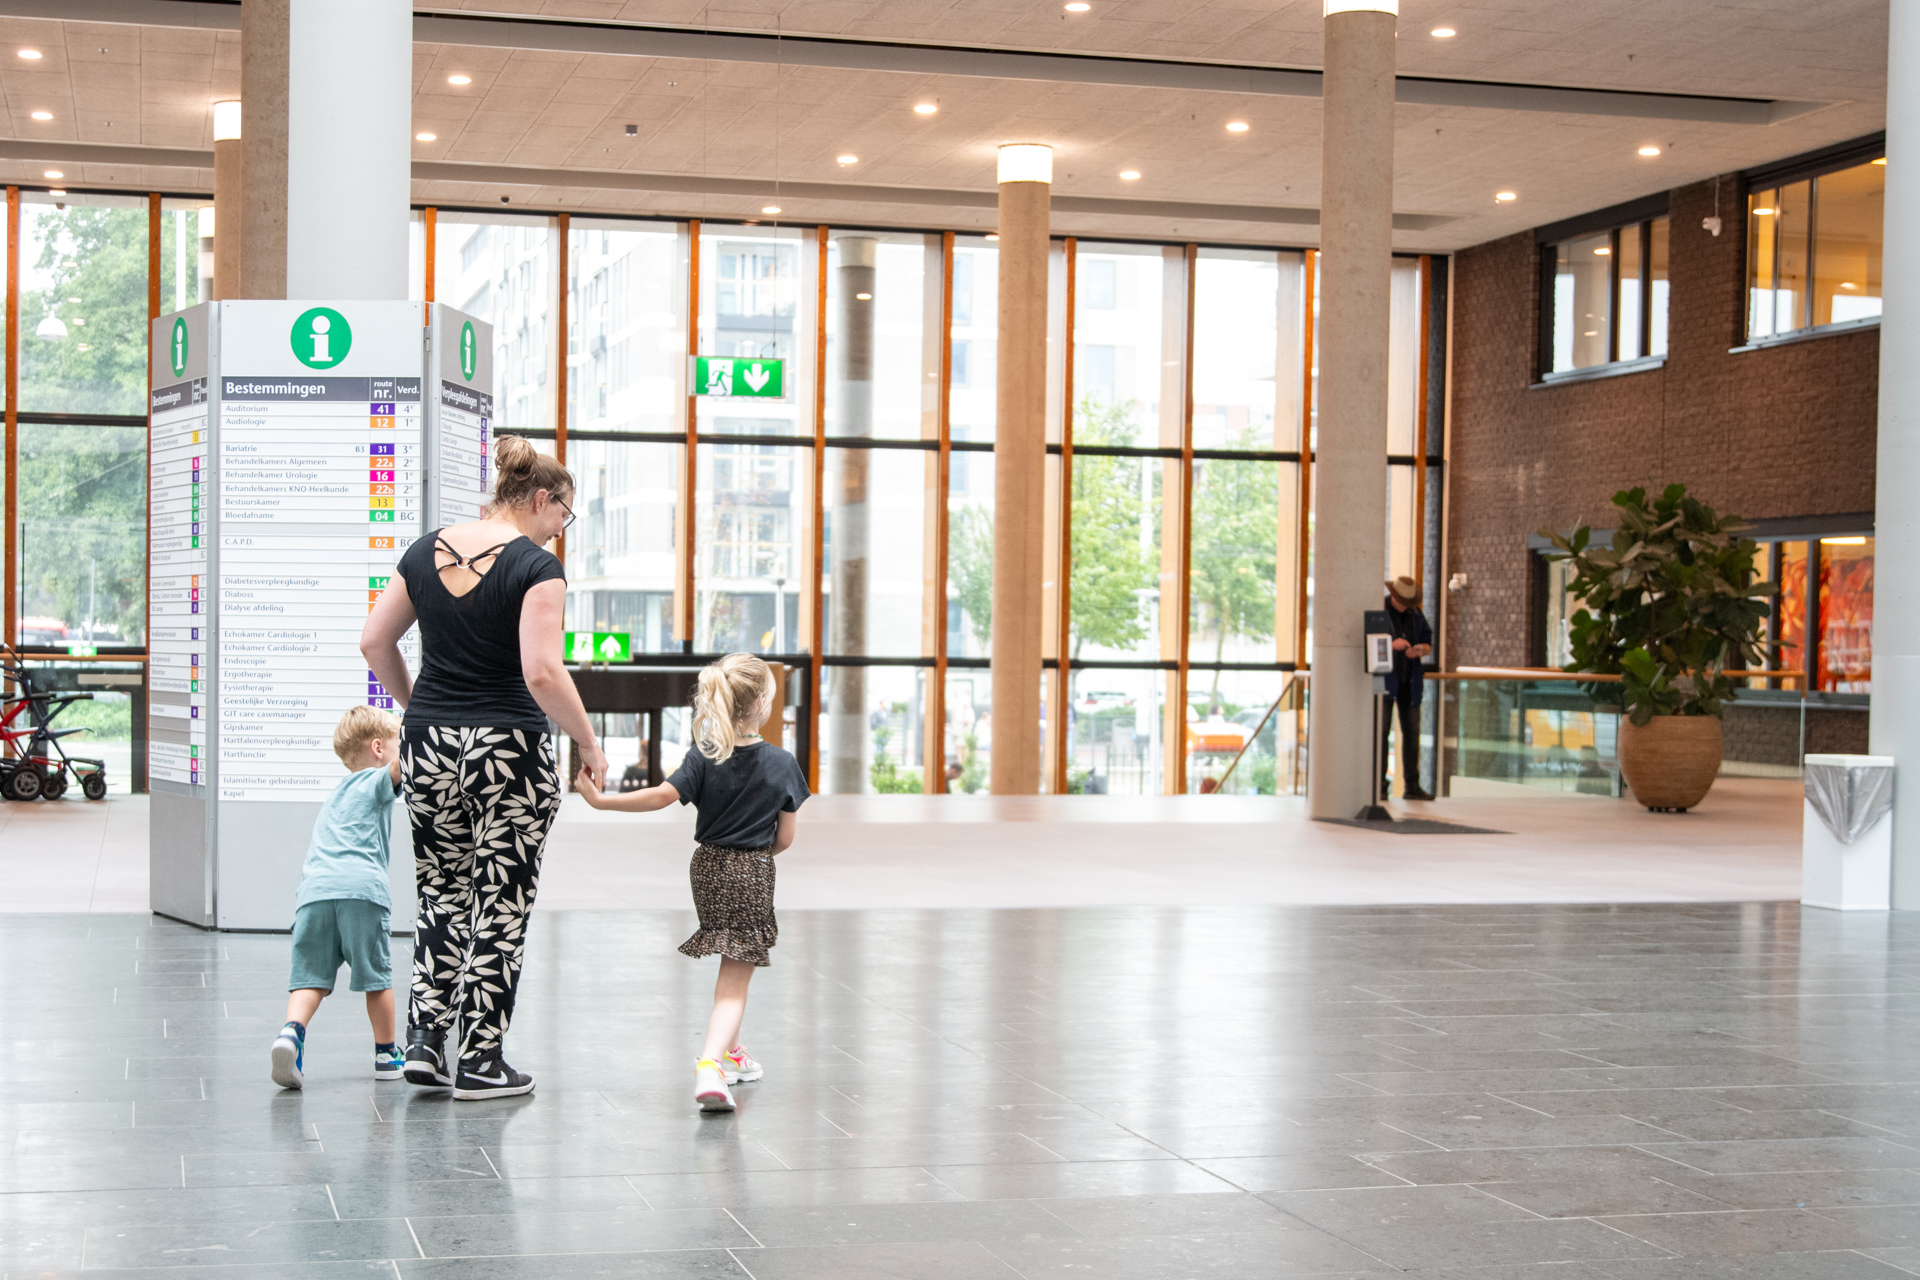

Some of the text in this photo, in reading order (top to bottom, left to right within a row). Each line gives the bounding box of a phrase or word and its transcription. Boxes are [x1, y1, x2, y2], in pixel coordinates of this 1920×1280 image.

[226, 382, 326, 396] Bestemmingen
[374, 389, 392, 398] nr.
[397, 386, 420, 394] Verd.
[153, 391, 181, 407] Bestemmingen
[377, 404, 389, 414] 41
[225, 418, 267, 426] Audiologie
[376, 418, 388, 428] 12
[378, 446, 387, 454] 31
[288, 458, 328, 466] Algemeen
[376, 458, 393, 468] 22a
[225, 470, 283, 478] Behandelkamer
[285, 472, 318, 480] Urologie
[376, 471, 388, 481] 16
[376, 485, 394, 494] 22b
[377, 498, 388, 507] 13
[375, 512, 388, 521] 04
[400, 512, 414, 521] BG
[375, 538, 388, 548] 02
[225, 578, 388, 588] Diabetesverpleegkundige 14
[225, 604, 284, 614] Dialyse afdeling
[268, 645, 311, 654] Cardiologie
[224, 671, 273, 680] Ergotherapie
[224, 684, 386, 694] Fysiotherapie 11
[266, 699, 308, 708] Verzorging
[374, 698, 387, 708] 81
[224, 724, 264, 732] Gipskamer
[224, 737, 321, 746] Hartfalenverpleegkundige
[268, 778, 321, 786] gebedsruimte
[224, 790, 245, 798] Kapel
